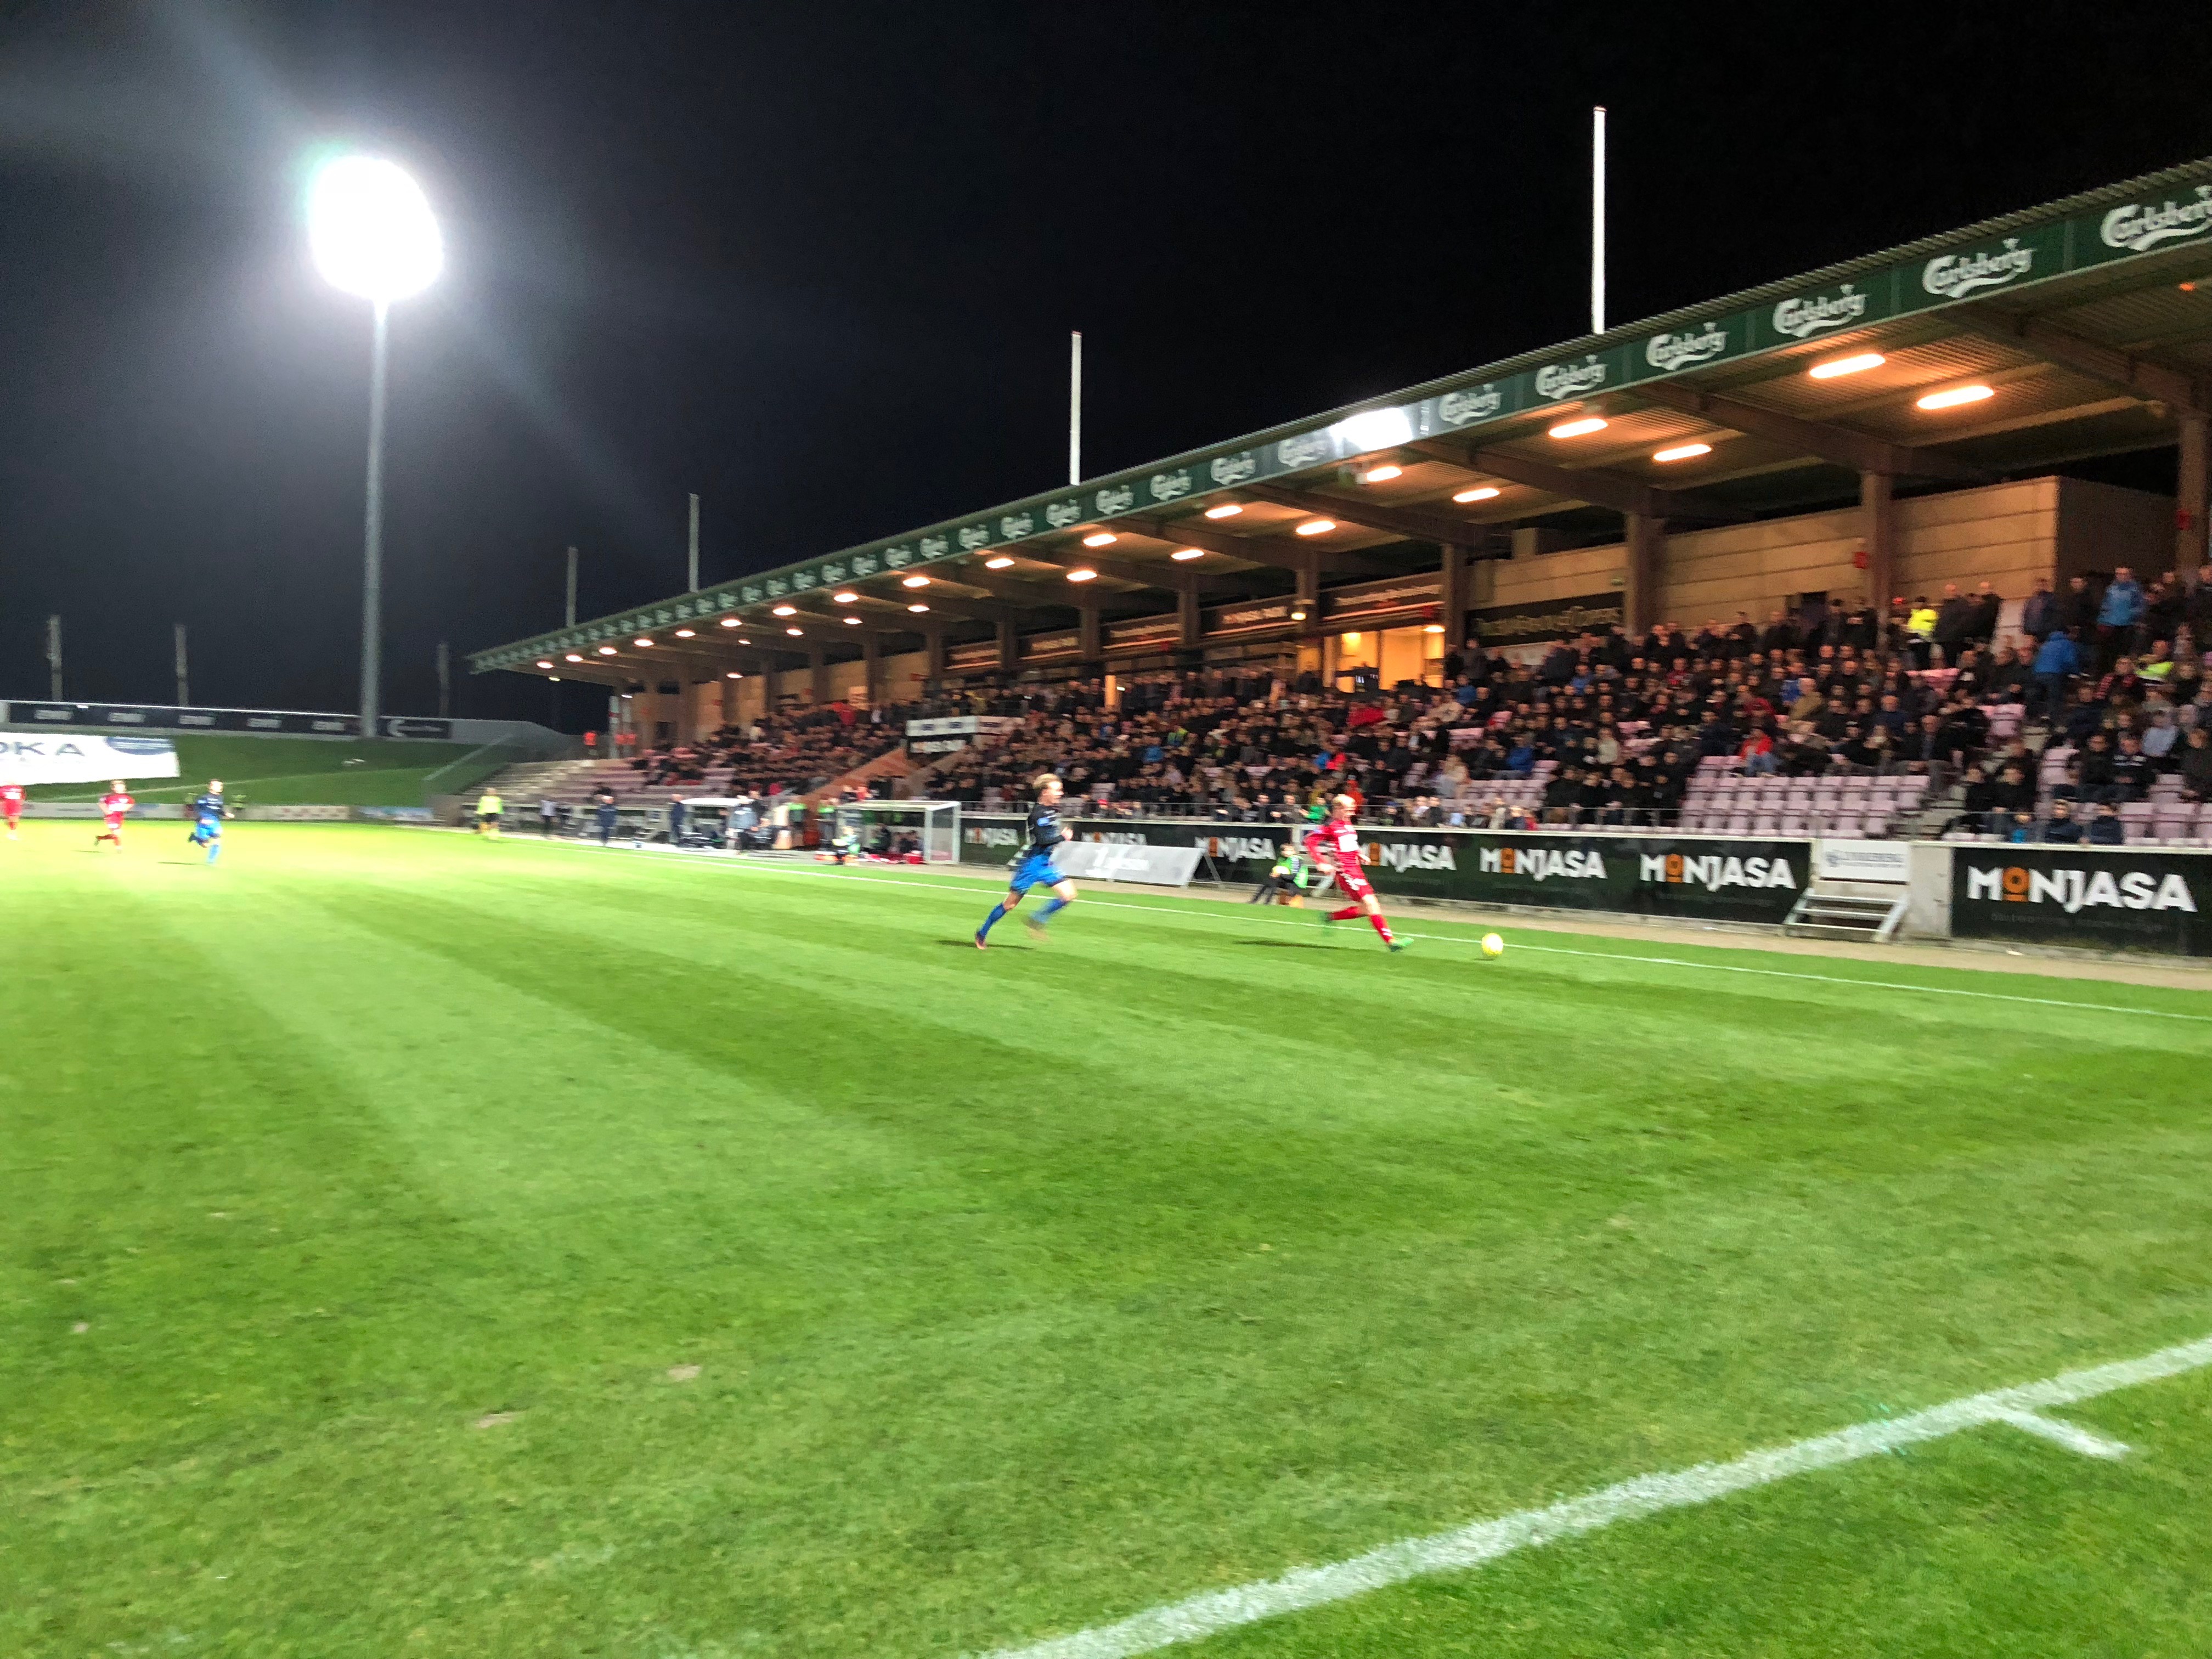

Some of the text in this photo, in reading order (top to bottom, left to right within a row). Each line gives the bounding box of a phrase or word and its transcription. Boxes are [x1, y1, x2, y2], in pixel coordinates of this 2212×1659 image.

[1922, 238, 2036, 298] Carlsberg
[1773, 284, 1870, 337] Carlsberg
[1480, 847, 1608, 881] MONJASA
[1640, 853, 1797, 892] MONJASA
[1967, 866, 2198, 913] MONJASA
